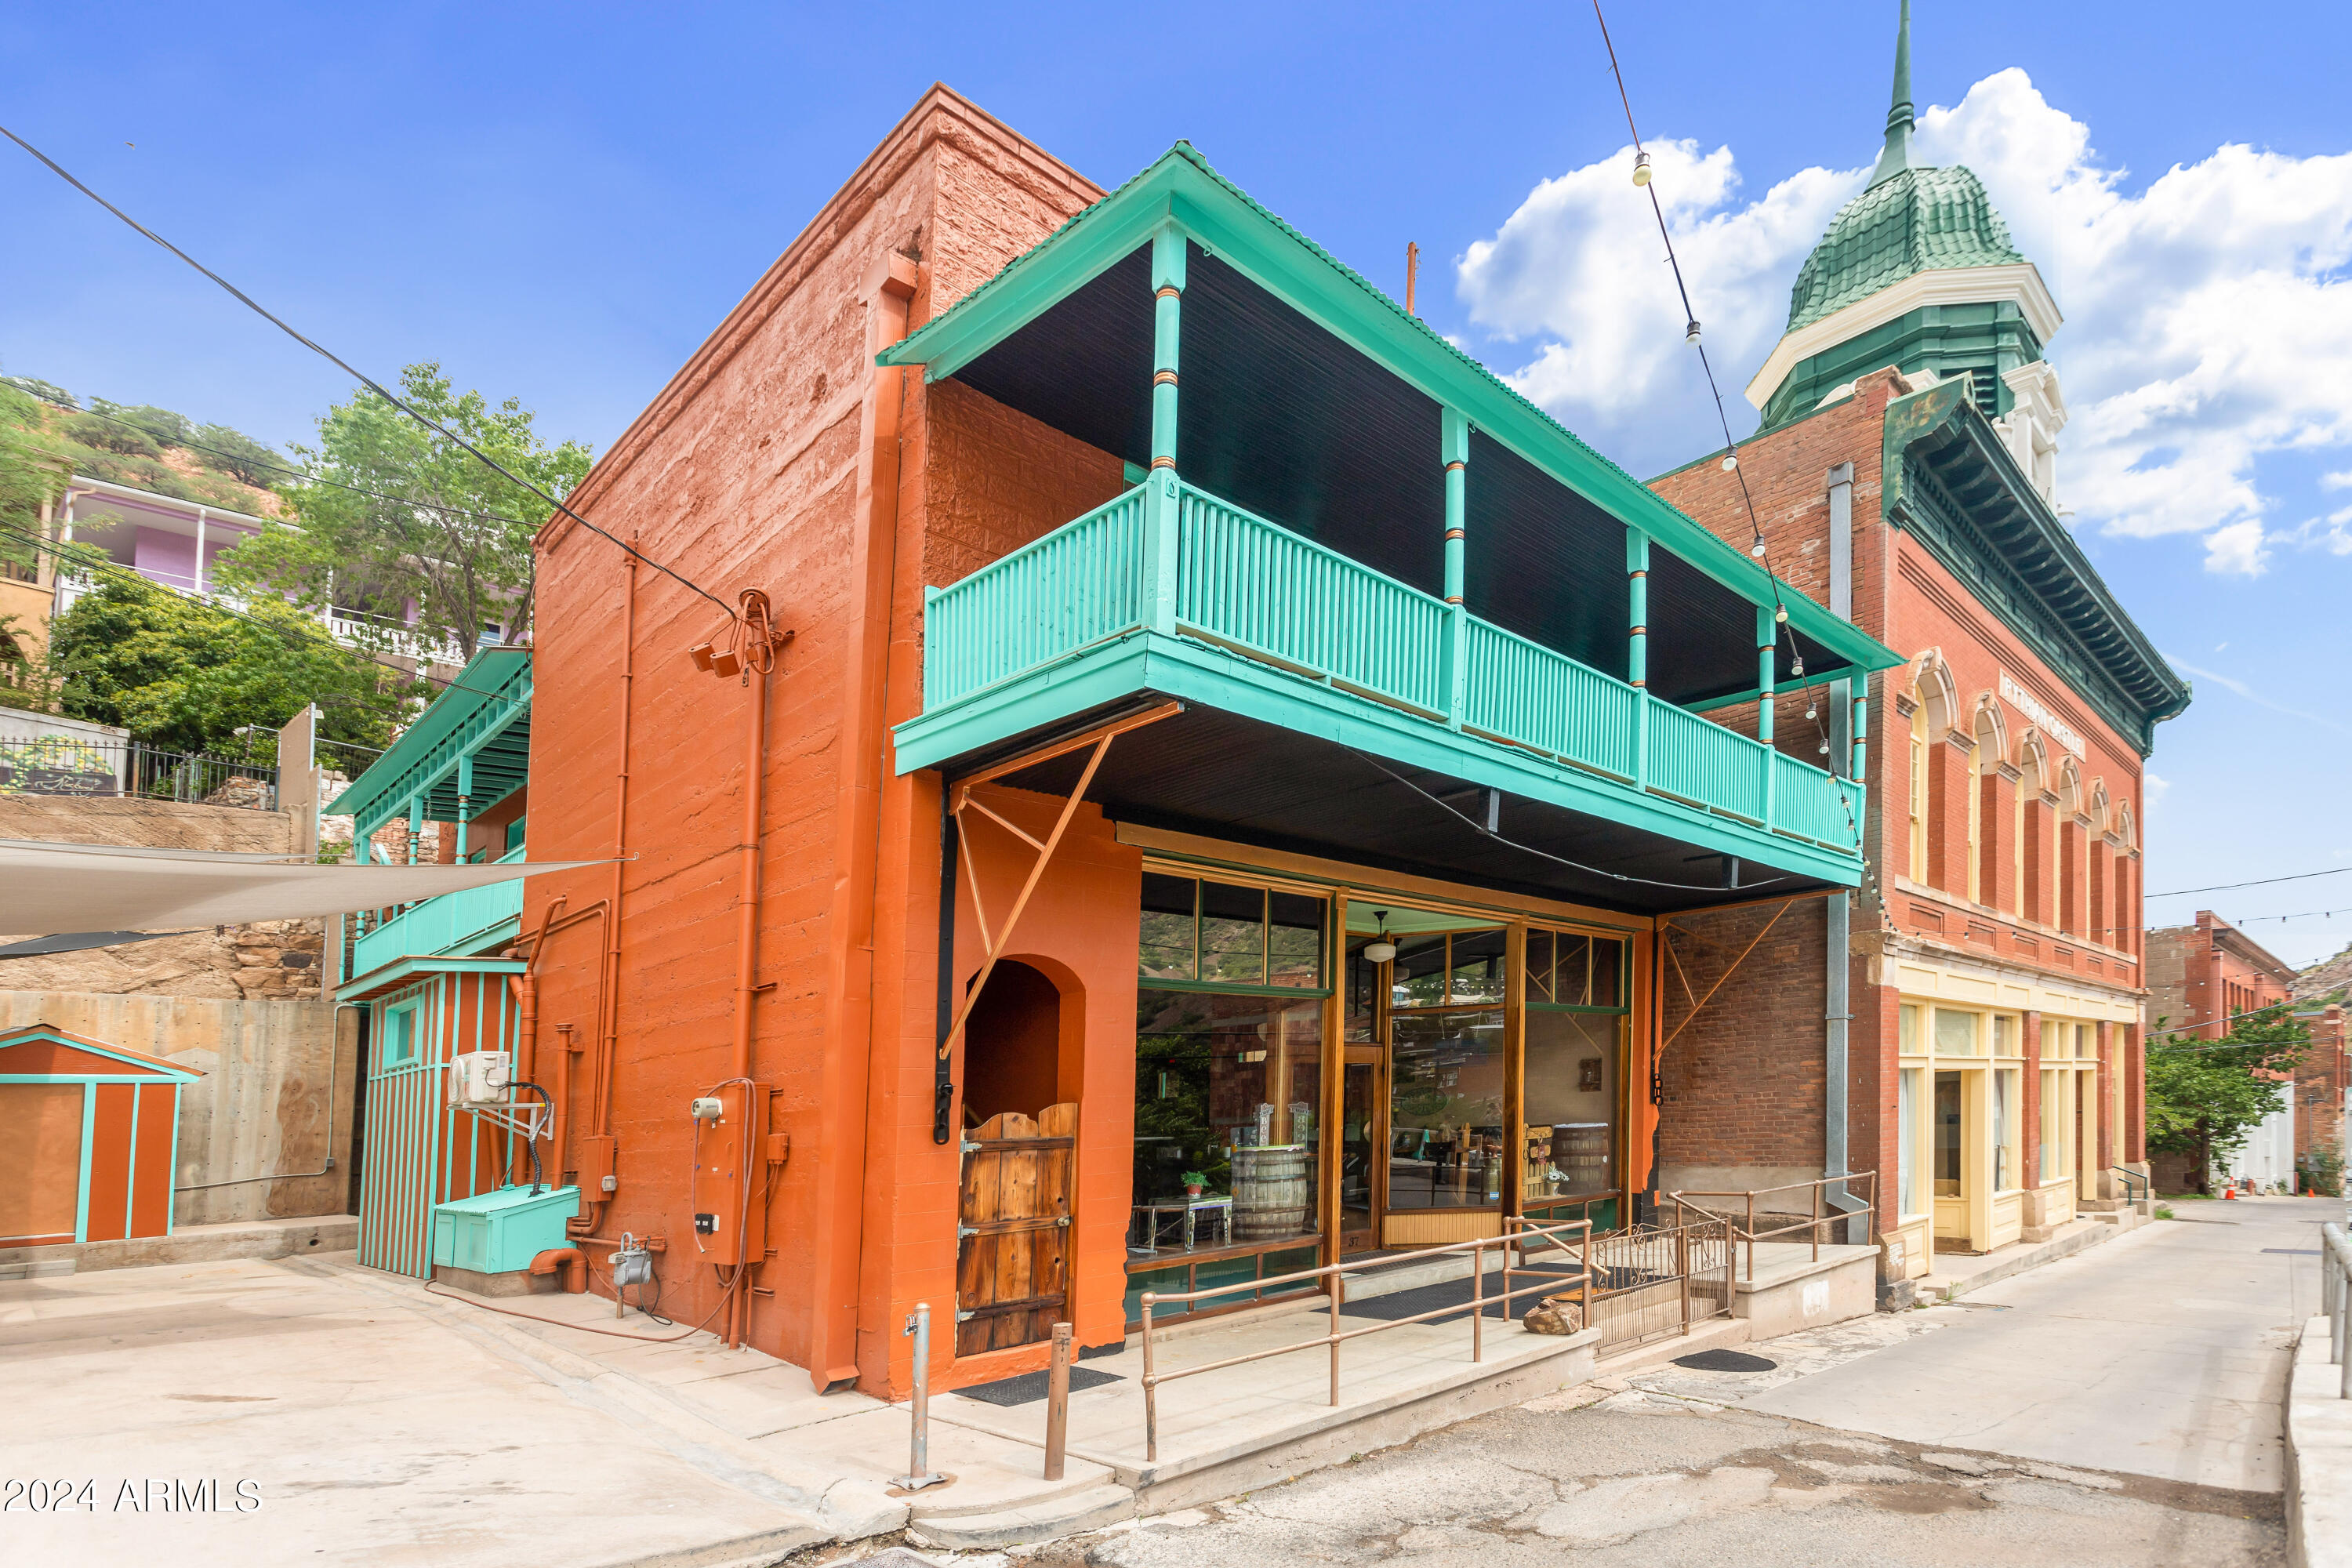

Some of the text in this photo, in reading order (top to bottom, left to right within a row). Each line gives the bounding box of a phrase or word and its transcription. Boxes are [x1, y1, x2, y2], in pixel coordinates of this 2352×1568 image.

[2003, 677, 2083, 757] PYTHIAN CASTLE
[1348, 1236, 1360, 1247] 37
